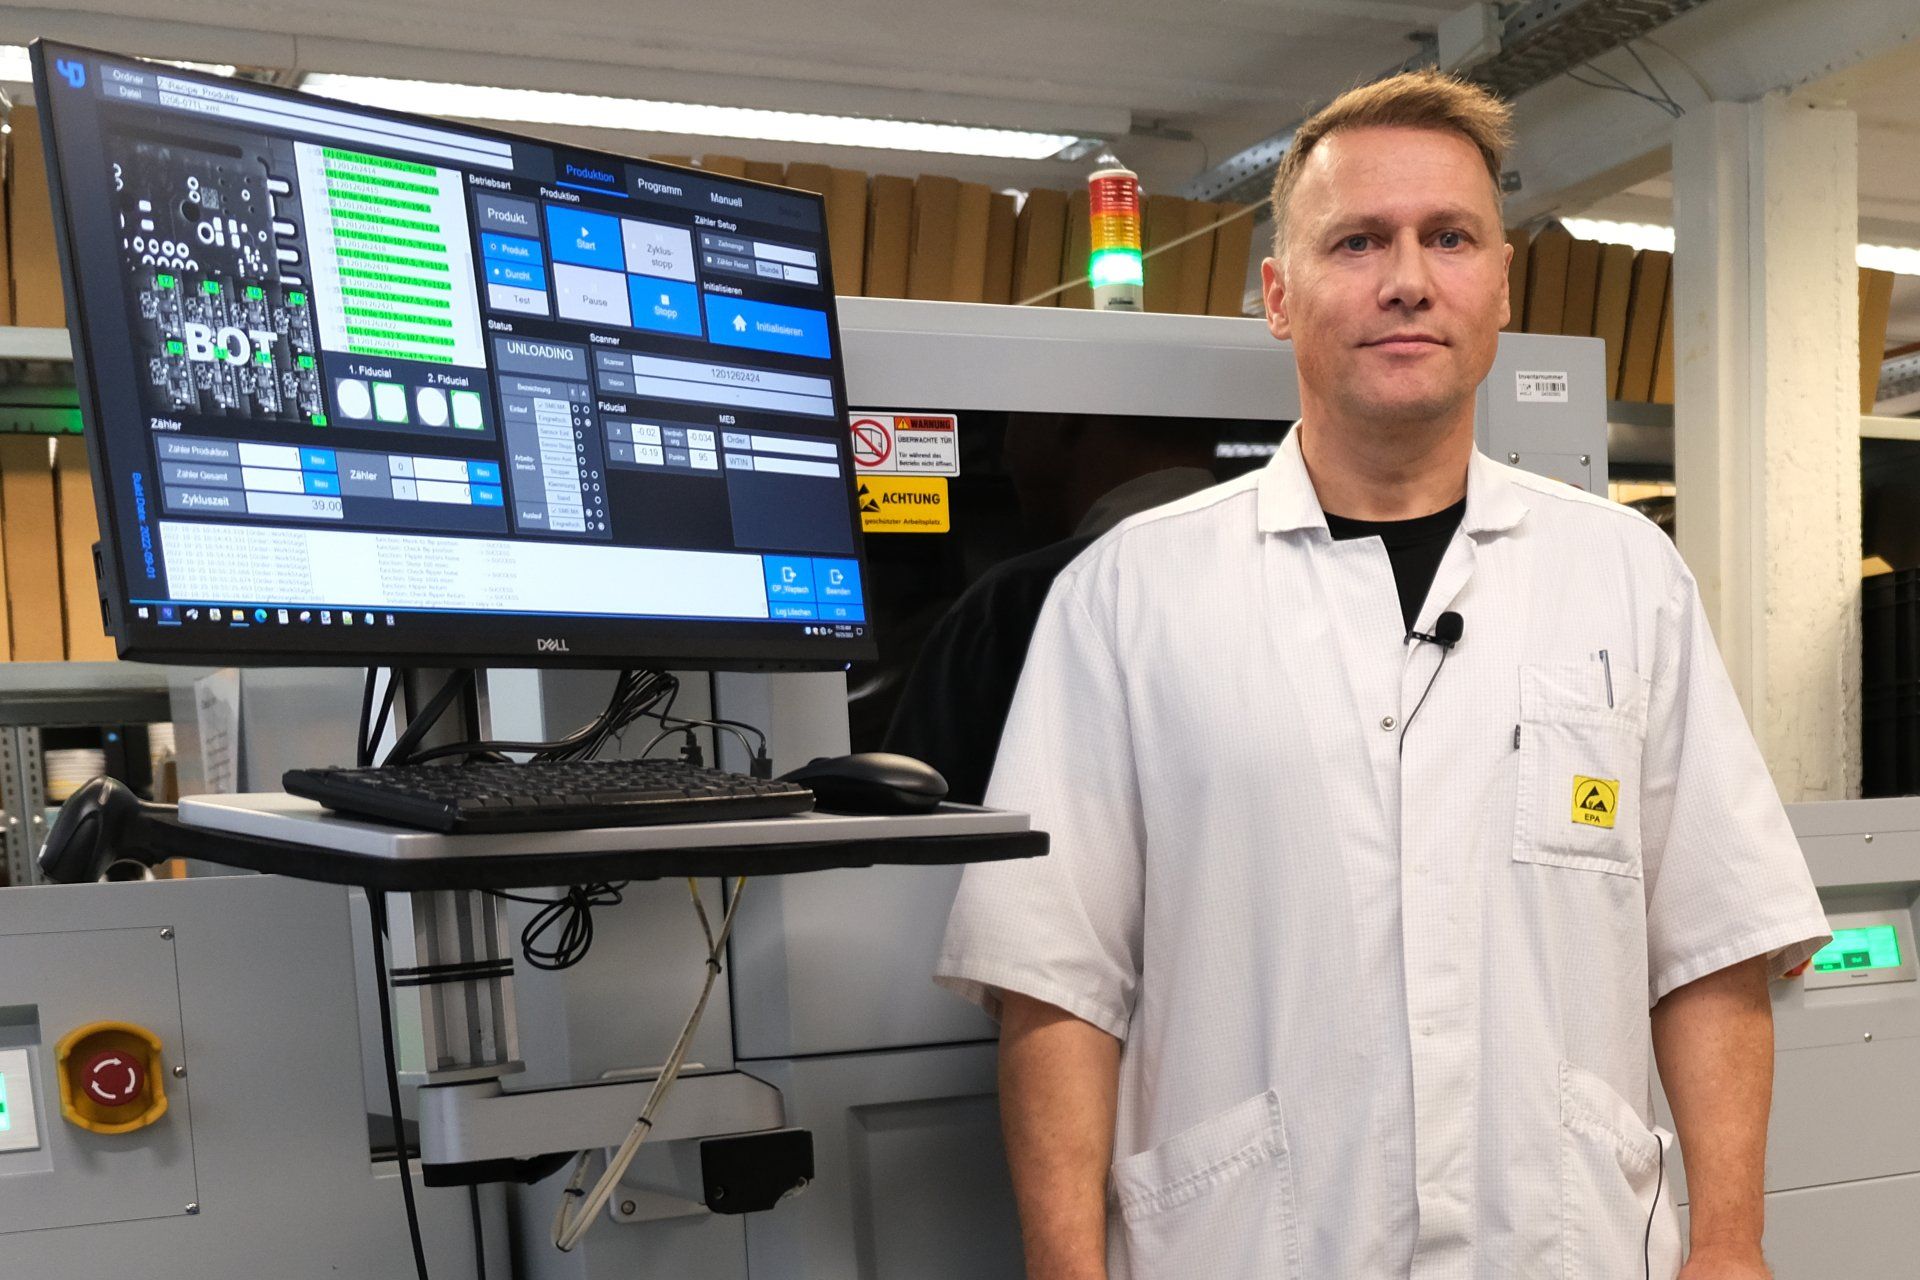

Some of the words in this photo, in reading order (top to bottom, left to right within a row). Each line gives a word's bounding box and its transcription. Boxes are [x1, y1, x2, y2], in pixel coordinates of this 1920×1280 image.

[113, 70, 144, 85] Ordner
[120, 86, 142, 99] Datei
[566, 164, 614, 183] Produktion
[469, 174, 512, 190] Betriebsart
[638, 178, 682, 196] Programm
[540, 188, 580, 202] Produktion
[710, 192, 742, 208] Manuell
[488, 208, 528, 224] Produkt.
[718, 219, 737, 232] Setup
[576, 238, 596, 250] Start
[704, 282, 742, 295] Initialisieren
[514, 295, 530, 304] Test
[582, 295, 608, 306] Pause
[654, 306, 678, 319] Stopp
[488, 320, 513, 331] Status
[756, 321, 804, 336] Initialisieren
[185, 321, 278, 368] BOT
[590, 333, 620, 345] Scanner
[507, 342, 574, 360] UNLOADING
[349, 364, 356, 374] 1.
[359, 366, 392, 378] Fiducial
[712, 368, 760, 383] 1201262424
[428, 374, 436, 383] 2.
[438, 375, 469, 386] Fiducial
[598, 402, 627, 414] Fiducial
[150, 418, 182, 431] Zähler
[719, 414, 736, 424] MES
[911, 420, 950, 429] WARNUNG
[726, 435, 746, 445] Order
[192, 446, 228, 457] Produktion
[350, 470, 378, 480] Zähler
[182, 494, 230, 508] Zykluszeit
[312, 500, 342, 512] 39.00
[882, 492, 940, 504] ACHTUNG
[776, 608, 786, 617] Log
[537, 638, 570, 651] DELL
[1585, 813, 1600, 822] EPA
